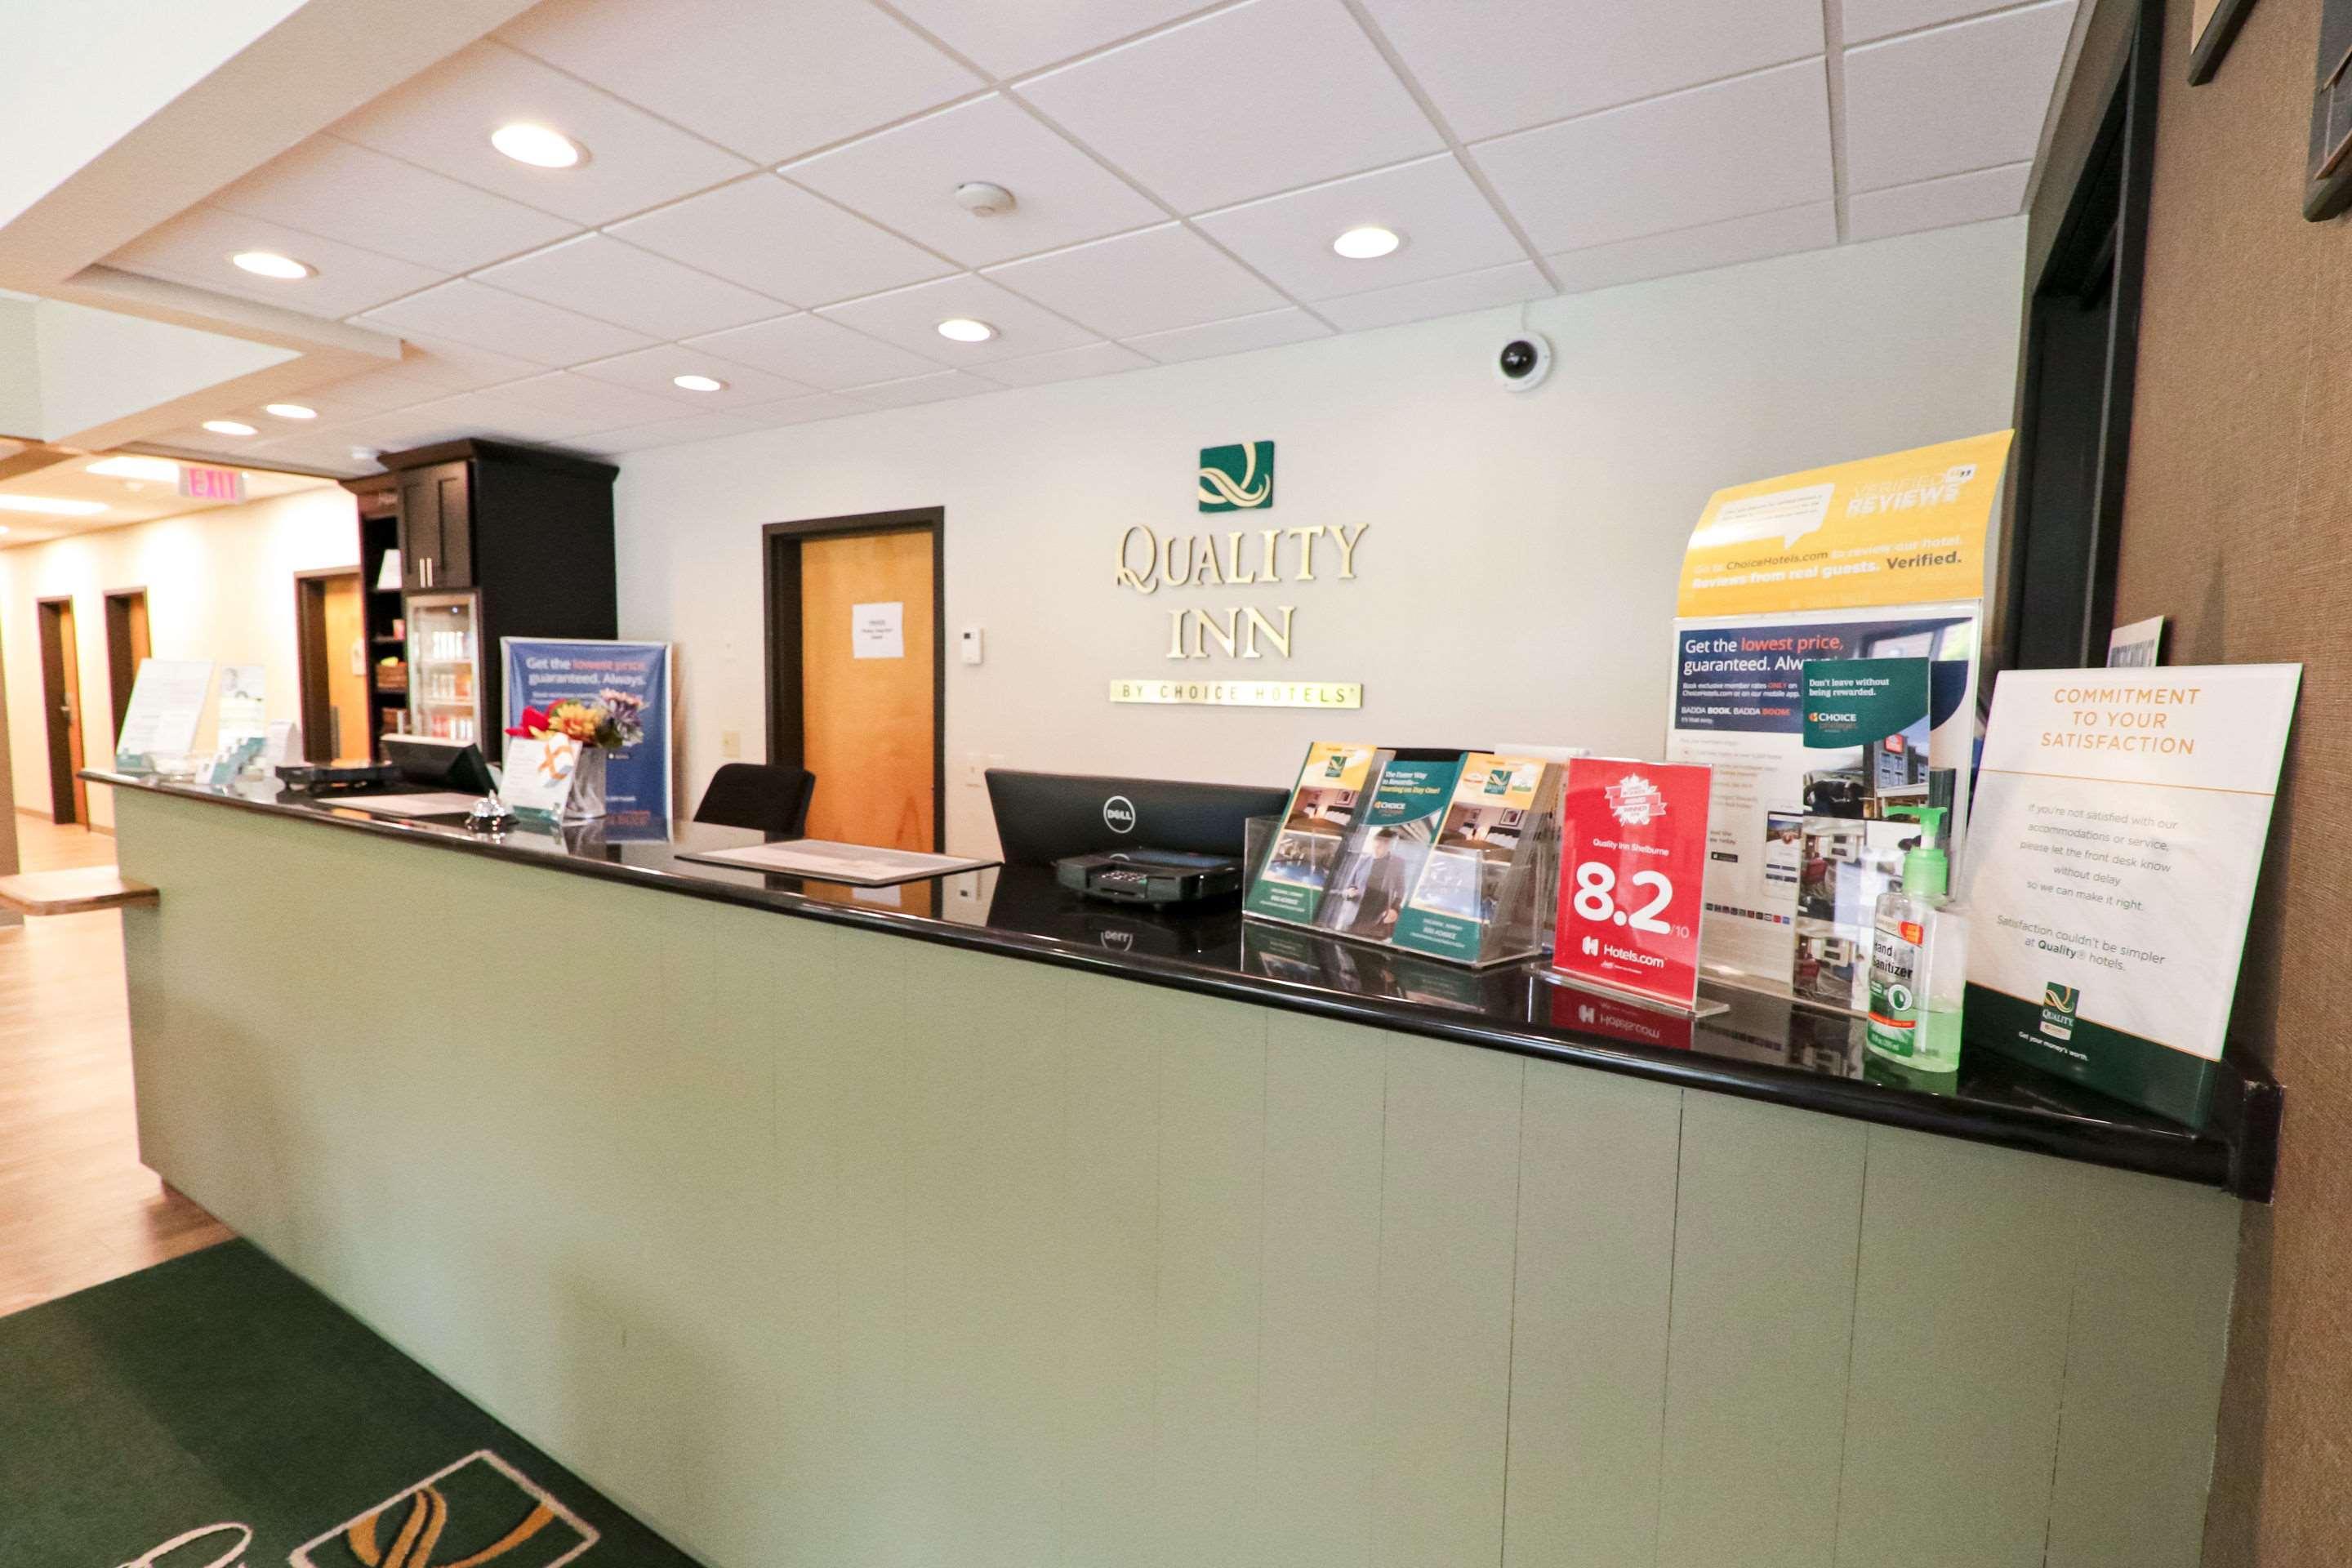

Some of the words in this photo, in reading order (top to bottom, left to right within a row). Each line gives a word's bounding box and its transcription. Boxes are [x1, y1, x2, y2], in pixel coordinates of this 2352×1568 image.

[189, 468, 239, 499] EXIT
[1846, 483, 1960, 518] REVIEWS
[1116, 522, 1370, 595] QUALITY
[1692, 575, 1747, 589] Reviews
[1750, 571, 1786, 583] from
[1789, 565, 1818, 579] real
[1822, 561, 1882, 579] guests.
[1886, 551, 1963, 570] Verified.
[1726, 550, 1829, 571] ChoiceHotels.com
[1165, 604, 1297, 659] INN
[1685, 639, 1711, 654] Get
[1713, 638, 1738, 653] the
[1740, 637, 1793, 652] lowest
[1797, 635, 1844, 654] price,
[1683, 656, 1771, 676] guaranteed.
[1123, 684, 1143, 697] BY
[1160, 684, 1237, 699] CHOICE
[1255, 685, 1345, 703] HOTELS
[1808, 679, 1831, 687] Don't
[1831, 678, 1855, 687] leave
[1855, 677, 1890, 686] without
[1808, 688, 1832, 697] being
[1832, 687, 1877, 697] rewarded.
[2054, 688, 2202, 705] COMMITMENT
[1819, 712, 1857, 723] CHOICE
[2072, 710, 2098, 727] TO
[2107, 711, 2168, 729] YOUR
[2041, 732, 2195, 755] SATISFACTION
[1107, 808, 1132, 821] DELL
[1381, 801, 1406, 810] CHOICE
[2036, 804, 2065, 817] you're
[2067, 808, 2084, 818] not
[2086, 810, 2129, 825] satisfied
[2131, 816, 2155, 827] with
[2157, 819, 2179, 831] our
[1592, 838, 1618, 850] Quality
[1618, 841, 1631, 850] Inn
[1631, 843, 1670, 857] Shelburne
[2027, 822, 2111, 843] accommodations
[2113, 835, 2126, 844] or
[2127, 836, 2170, 853] service,
[2019, 840, 2050, 853] please
[2051, 844, 2064, 855] let
[2065, 847, 2082, 858] the
[2083, 849, 2109, 862] front
[2111, 854, 2137, 867] desk
[2140, 859, 2172, 873] know
[2052, 865, 2091, 880] without
[2092, 872, 2122, 888] delay
[1573, 861, 1674, 935] 8.2
[2026, 880, 2038, 890] so
[2040, 883, 2054, 893] we
[2055, 885, 2074, 898] can
[2075, 890, 2105, 904] make
[2105, 896, 2114, 906] it
[2115, 898, 2145, 911] right.
[1996, 915, 2053, 938] Satisfaction
[2054, 929, 2100, 950] couldn't
[2101, 940, 2118, 954] be
[2119, 945, 2167, 965] simpler
[1603, 943, 1664, 968] Hotels.com
[1872, 954, 1913, 979] Sanitizer
[2025, 938, 2036, 947] at
[2088, 951, 2127, 972] hotels.
[2042, 1009, 2075, 1027] QUALITY
